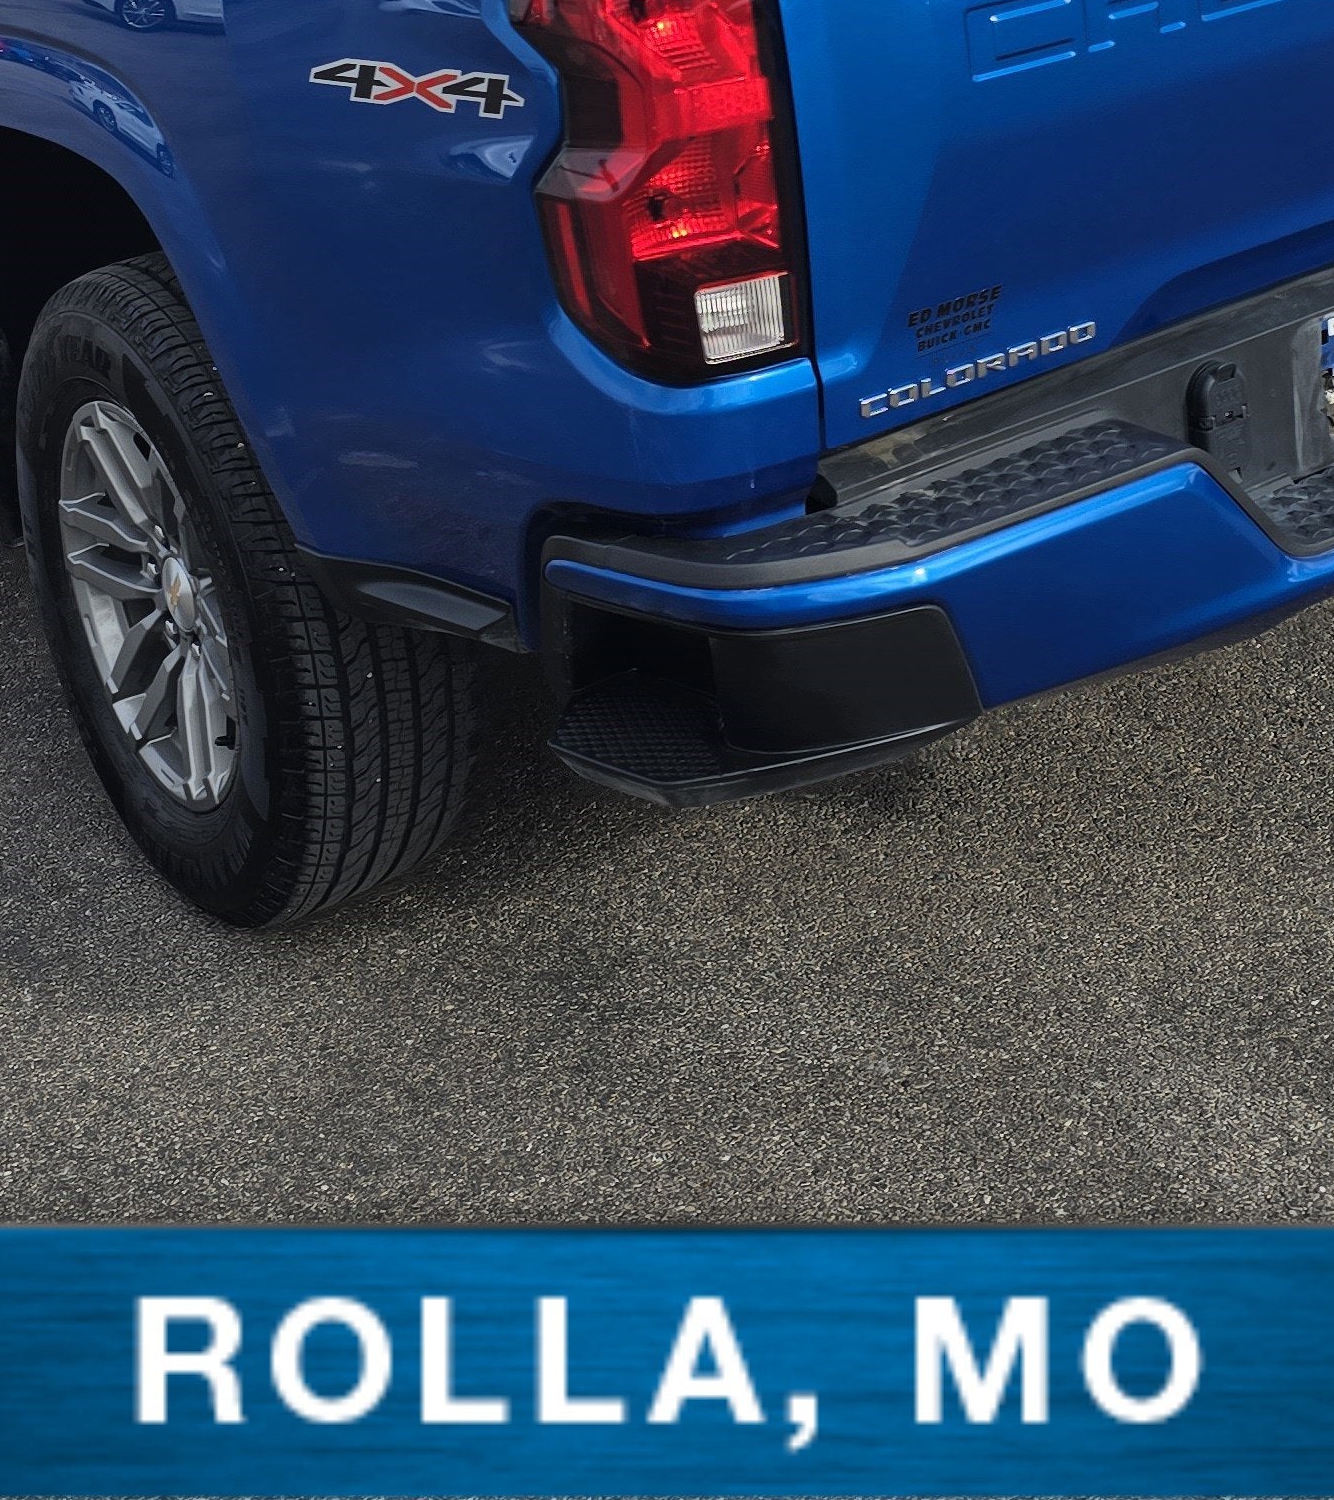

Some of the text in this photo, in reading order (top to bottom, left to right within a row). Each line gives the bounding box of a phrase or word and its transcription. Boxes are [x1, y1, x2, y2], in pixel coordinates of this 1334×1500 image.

[907, 284, 1003, 328] ED MORSE
[915, 303, 995, 339] CHEVROLET
[917, 330, 959, 352] BUICK
[859, 320, 1097, 420] COLORADO
